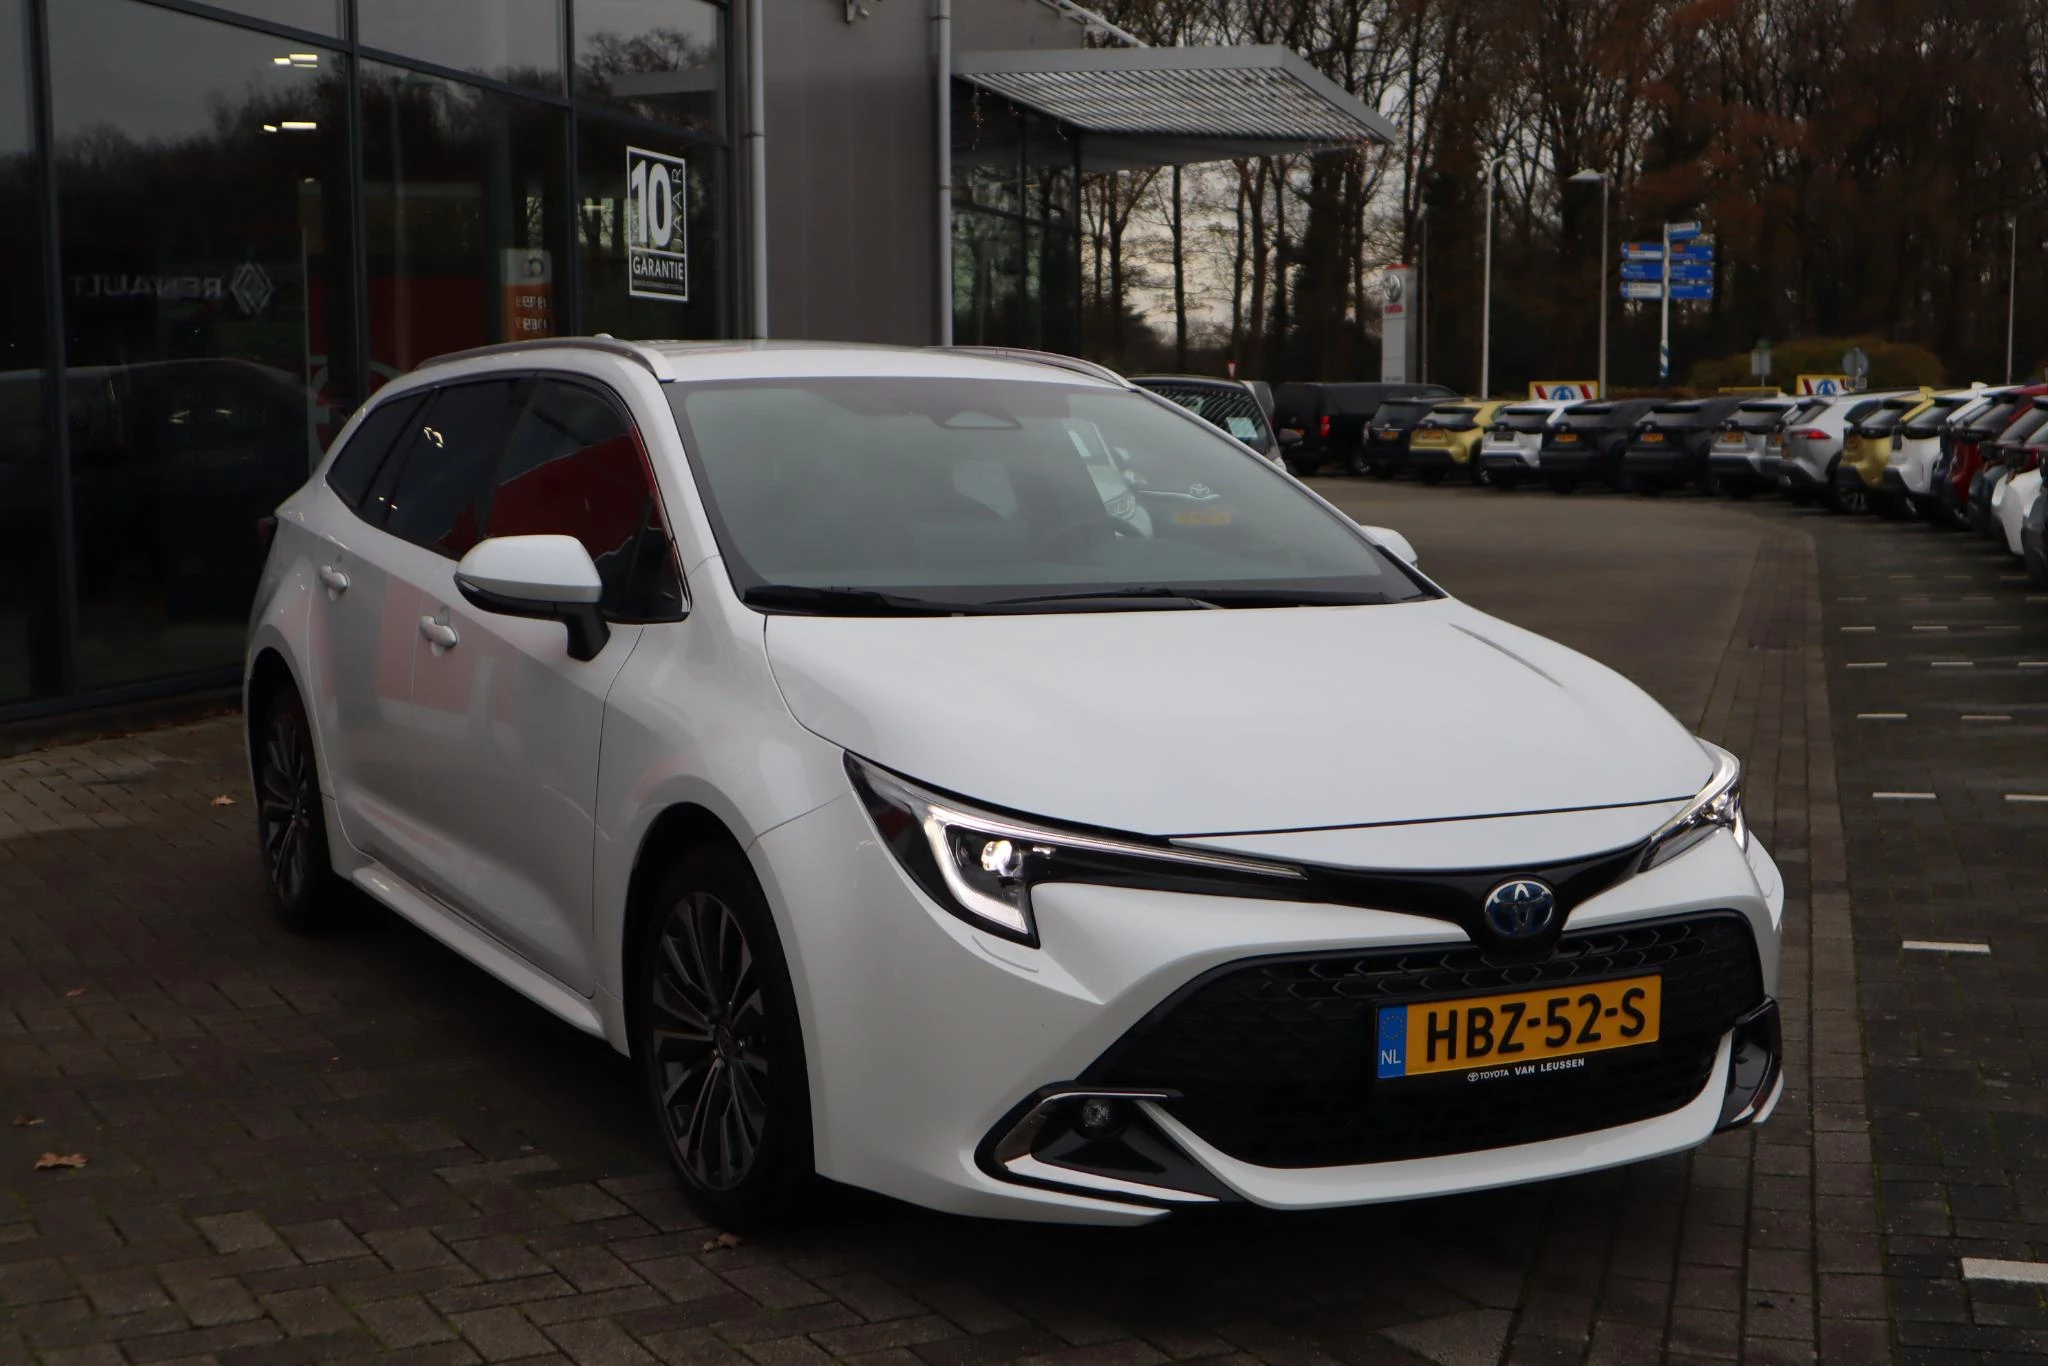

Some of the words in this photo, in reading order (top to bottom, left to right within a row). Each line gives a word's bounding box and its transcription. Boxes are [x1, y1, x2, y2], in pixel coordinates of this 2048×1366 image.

[631, 159, 673, 247] 10
[671, 167, 684, 249] JAAR
[632, 255, 684, 280] GARANTIE
[1427, 987, 1646, 1062] HBZ-52-S
[1381, 1048, 1402, 1066] NL
[1479, 1069, 1510, 1081] TOYOTA
[1514, 1065, 1535, 1076] VAN
[1539, 1057, 1585, 1073] LEUSSEN
